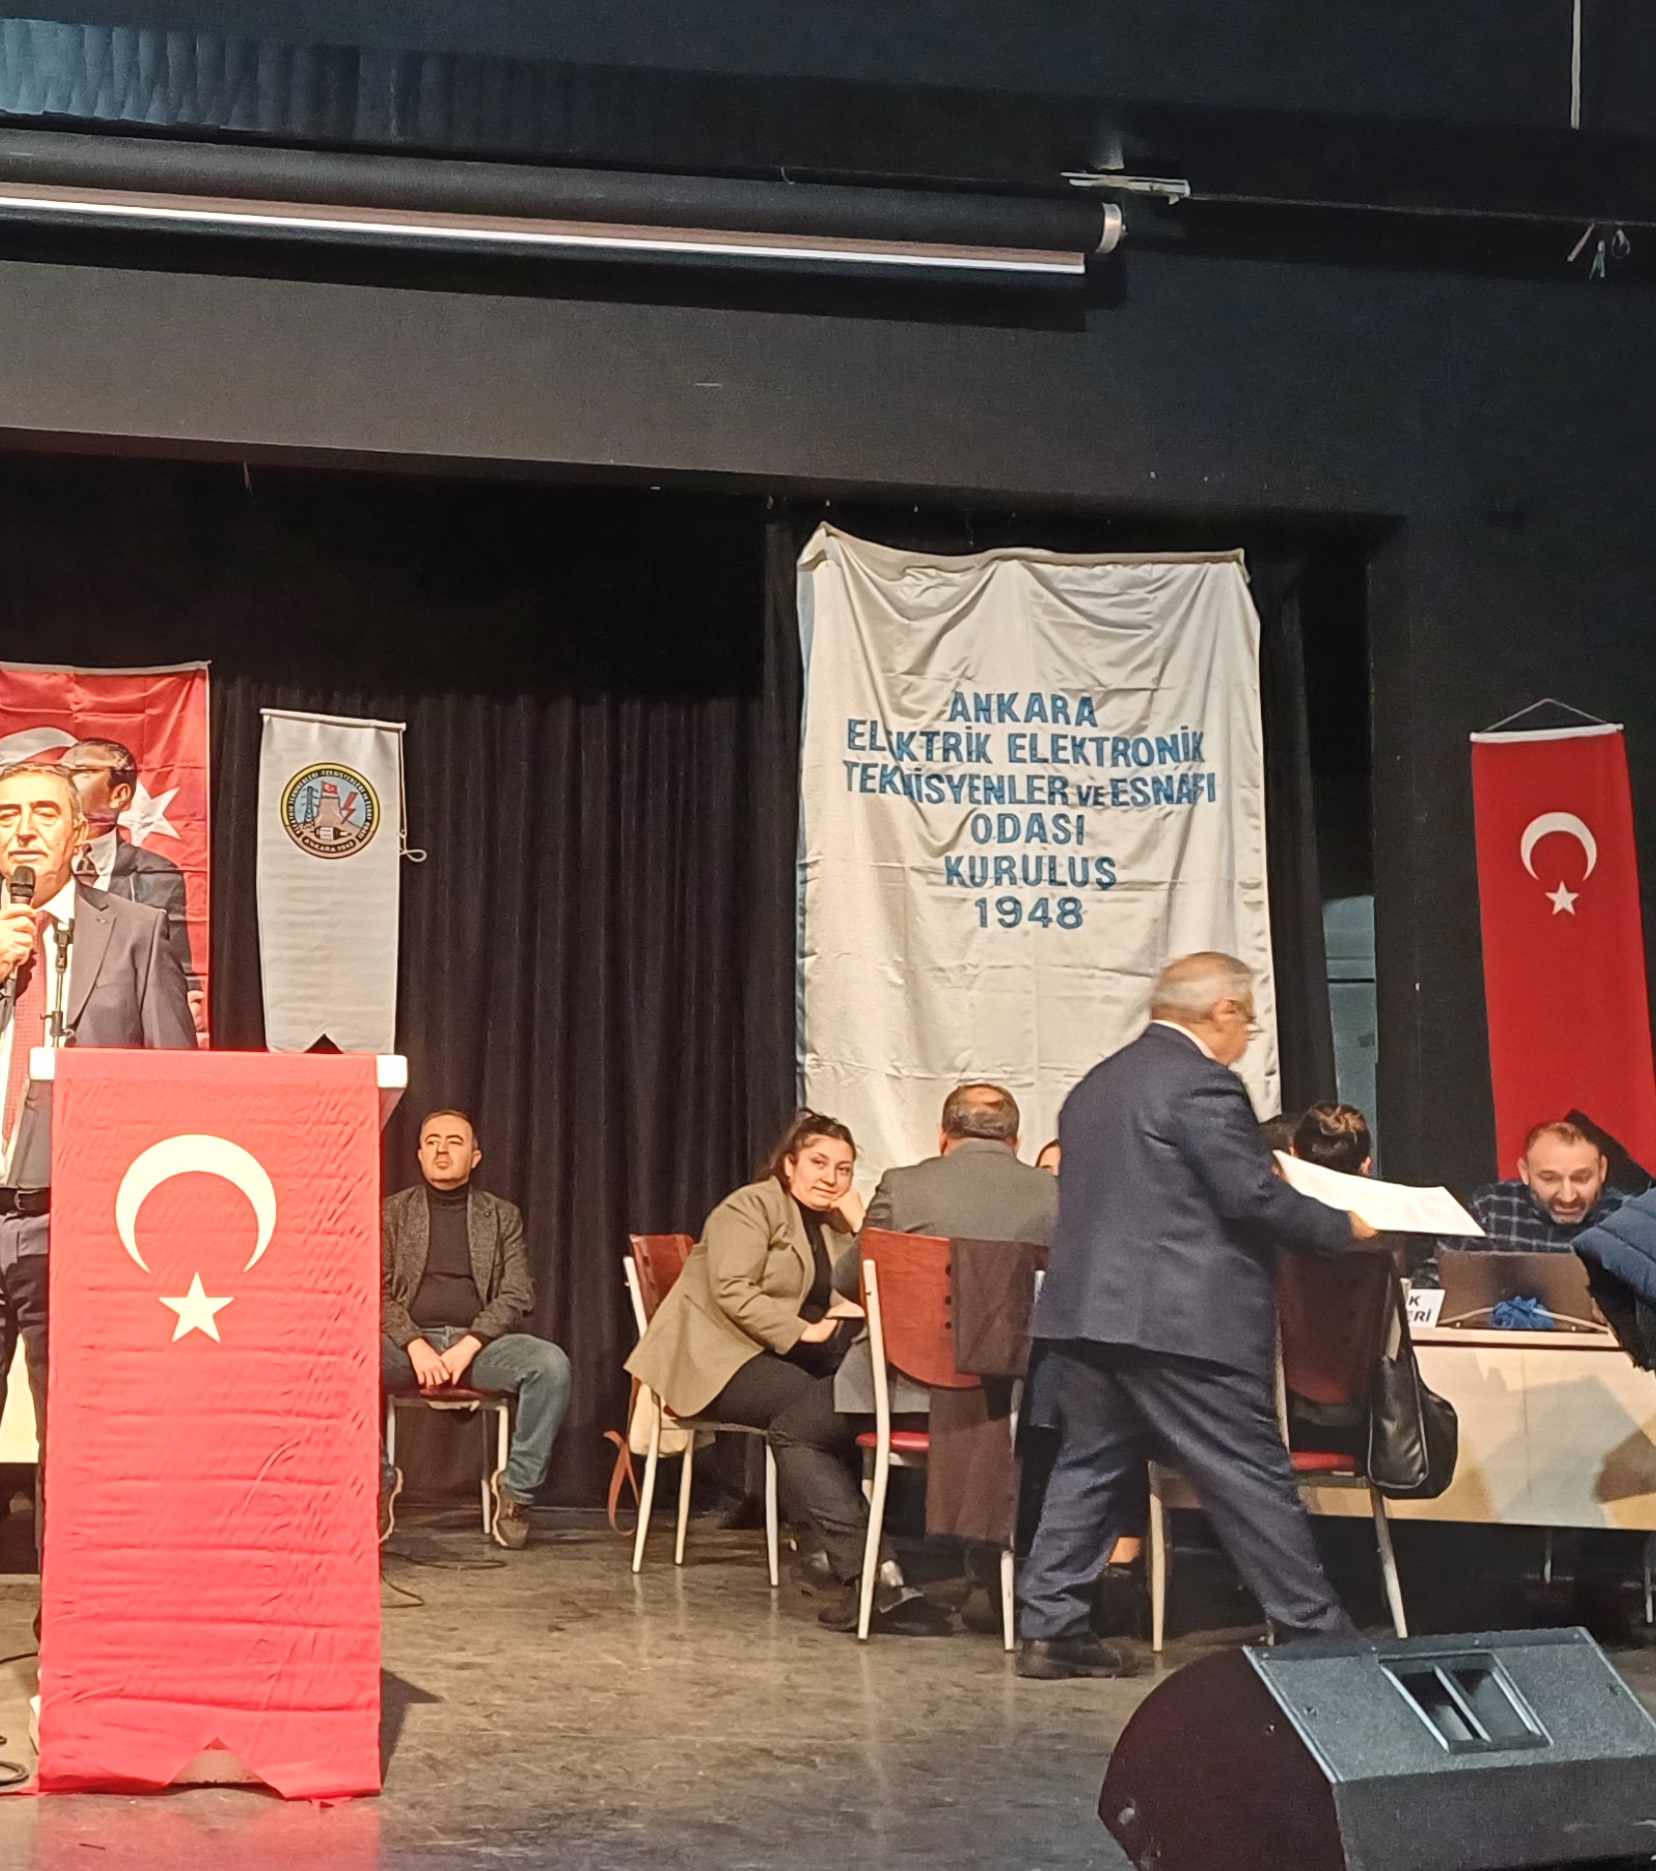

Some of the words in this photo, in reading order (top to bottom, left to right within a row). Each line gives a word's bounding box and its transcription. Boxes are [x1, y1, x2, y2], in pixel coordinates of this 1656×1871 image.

[948, 691, 1099, 728] ANKARA
[847, 718, 994, 764] ELKTRİK
[1007, 725, 1206, 768] ELEKTRONİK
[1109, 772, 1216, 807] ESNAFI
[970, 812, 1085, 846] ODASI
[944, 853, 1117, 891] KURULUŞ
[974, 895, 1084, 930] 1948
